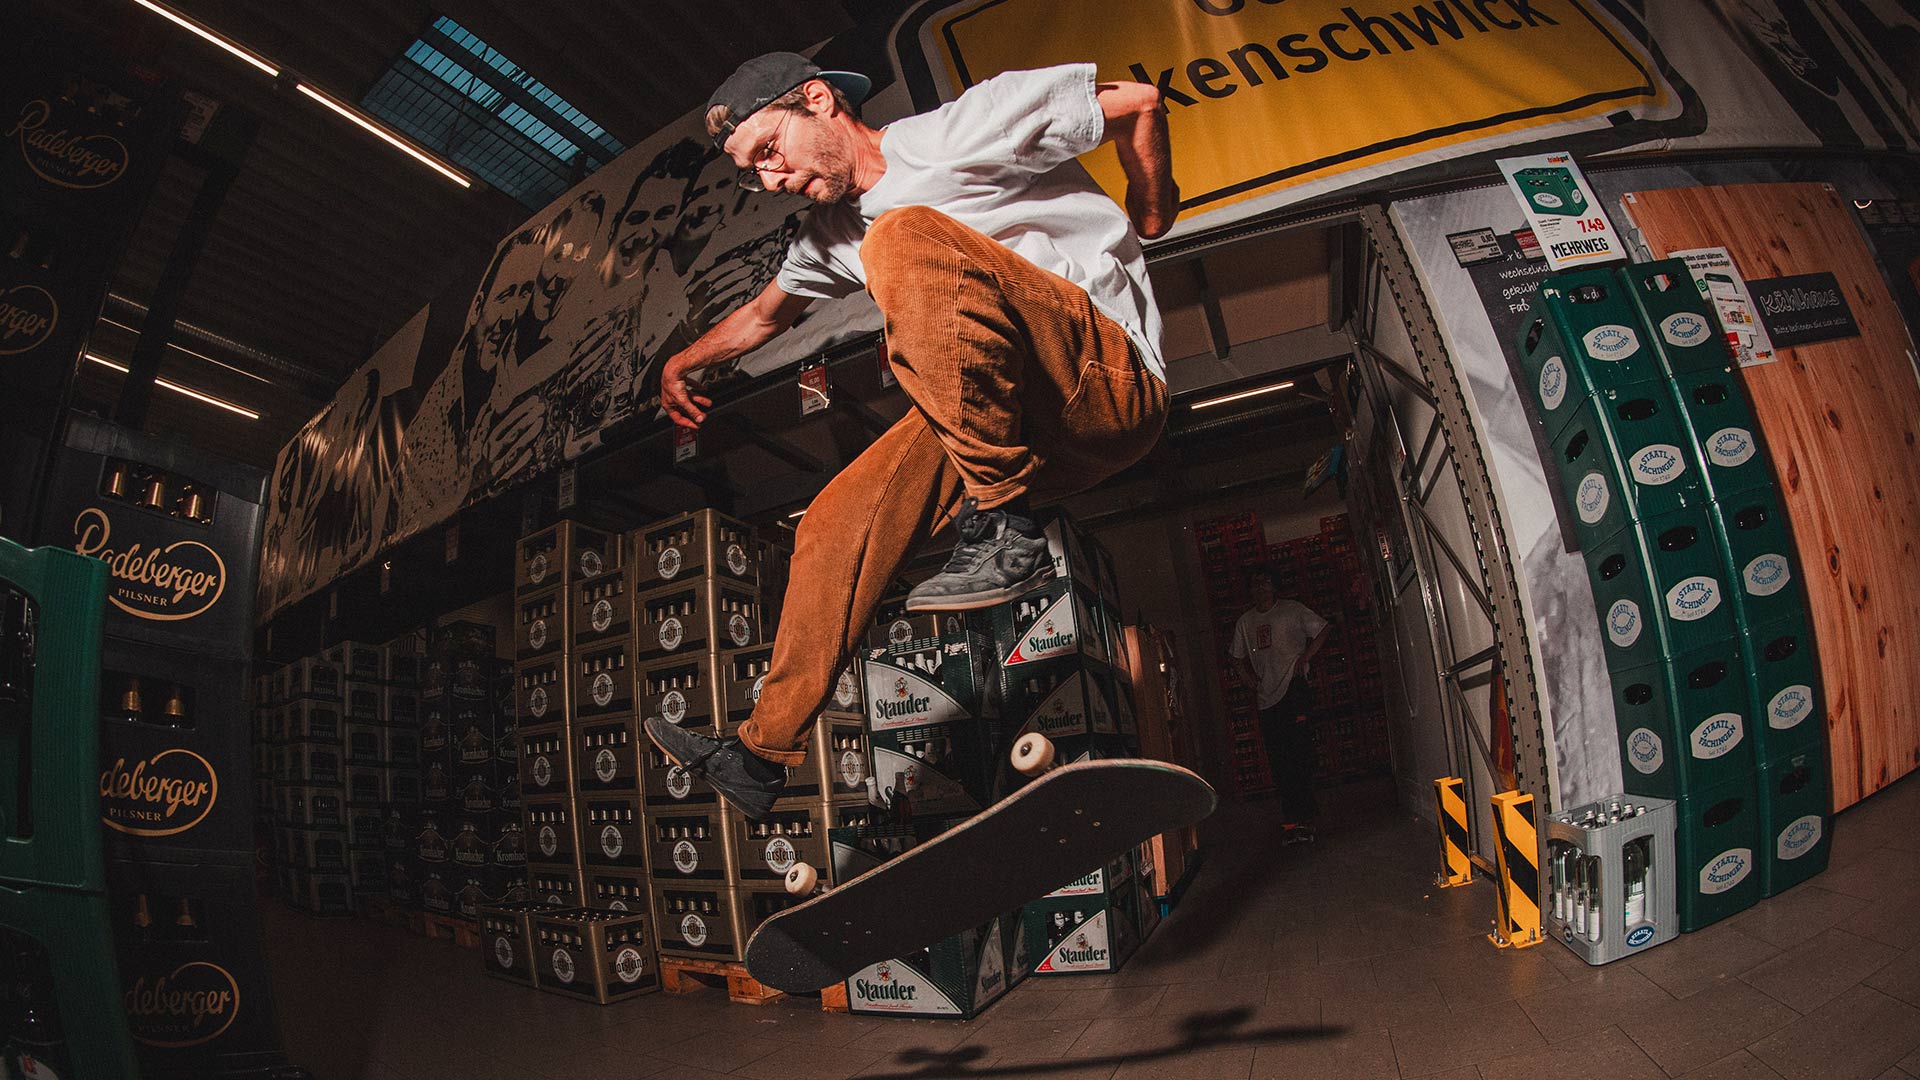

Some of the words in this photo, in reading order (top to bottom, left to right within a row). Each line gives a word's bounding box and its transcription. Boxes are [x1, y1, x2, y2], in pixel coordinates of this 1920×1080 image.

[1129, 0, 1560, 114] kenschwick
[5, 100, 119, 177] Radeberger
[1577, 218, 1605, 233] 7.49
[1550, 238, 1609, 259] MEHRWEG
[118, 588, 168, 607] PILSNER
[1029, 631, 1073, 653] Stauder
[876, 695, 931, 719] Stauder
[1037, 709, 1082, 731] Stauder
[100, 757, 209, 817] deberger
[110, 807, 162, 822] PILSNER
[758, 847, 803, 862] Warsteiner
[1059, 946, 1106, 964] Stauder
[856, 979, 916, 1001] Stauder
